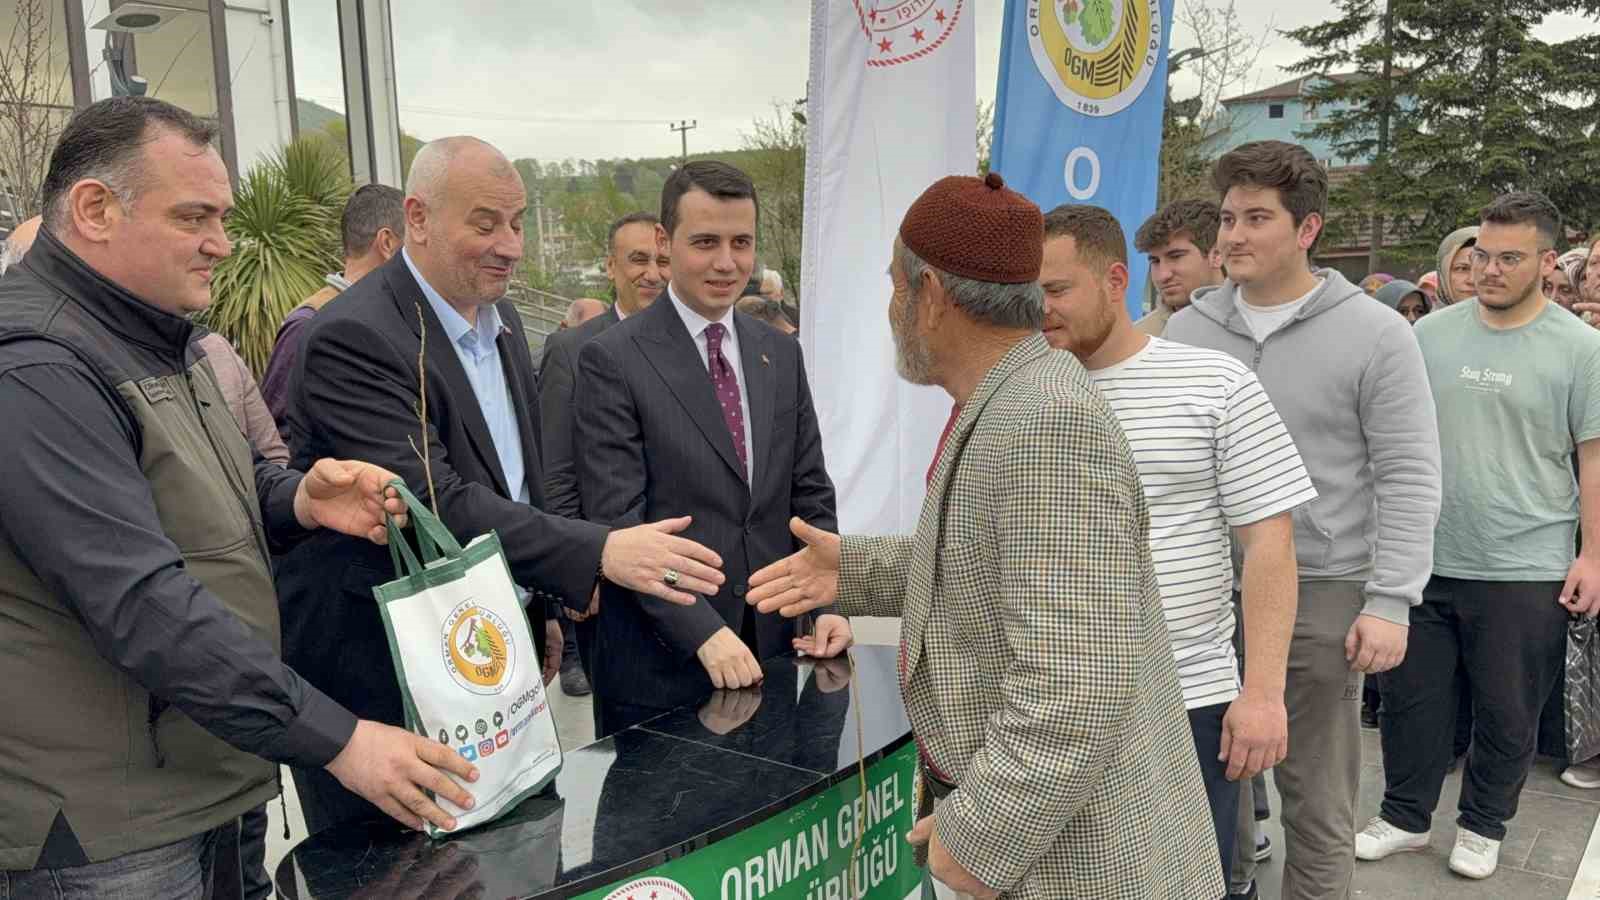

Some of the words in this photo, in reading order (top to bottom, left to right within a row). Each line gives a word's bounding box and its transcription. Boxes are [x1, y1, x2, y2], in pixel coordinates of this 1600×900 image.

[1029, 0, 1041, 37] OR
[1064, 47, 1096, 84] OGM
[1077, 101, 1100, 114] 1839
[1064, 146, 1100, 200] O
[720, 818, 828, 900] ORMAN
[836, 772, 905, 849] GENEL
